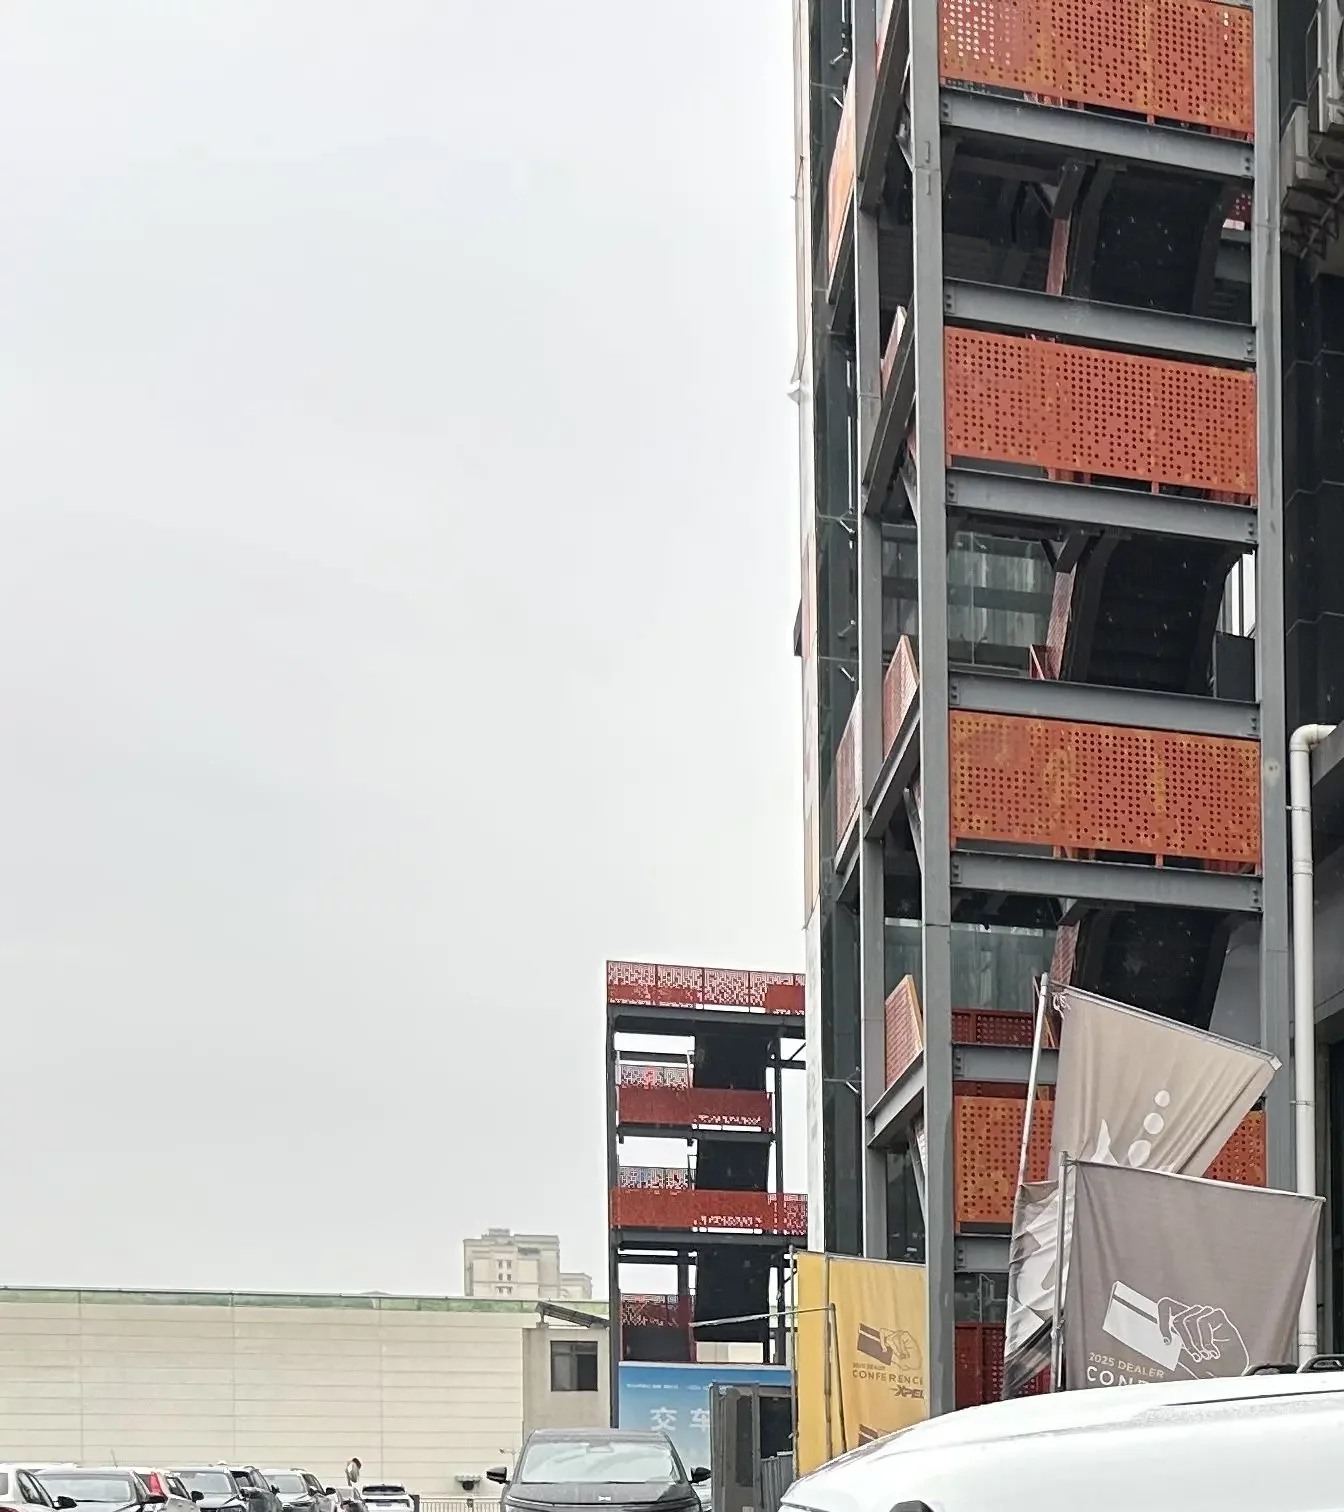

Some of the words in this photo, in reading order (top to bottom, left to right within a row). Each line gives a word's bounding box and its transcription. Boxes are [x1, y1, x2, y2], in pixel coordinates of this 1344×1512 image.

[1089, 1352, 1115, 1366] 2025
[1117, 1360, 1164, 1378] DEALER
[1087, 1366, 1149, 1386] CON
[894, 1385, 925, 1399] XPEL
